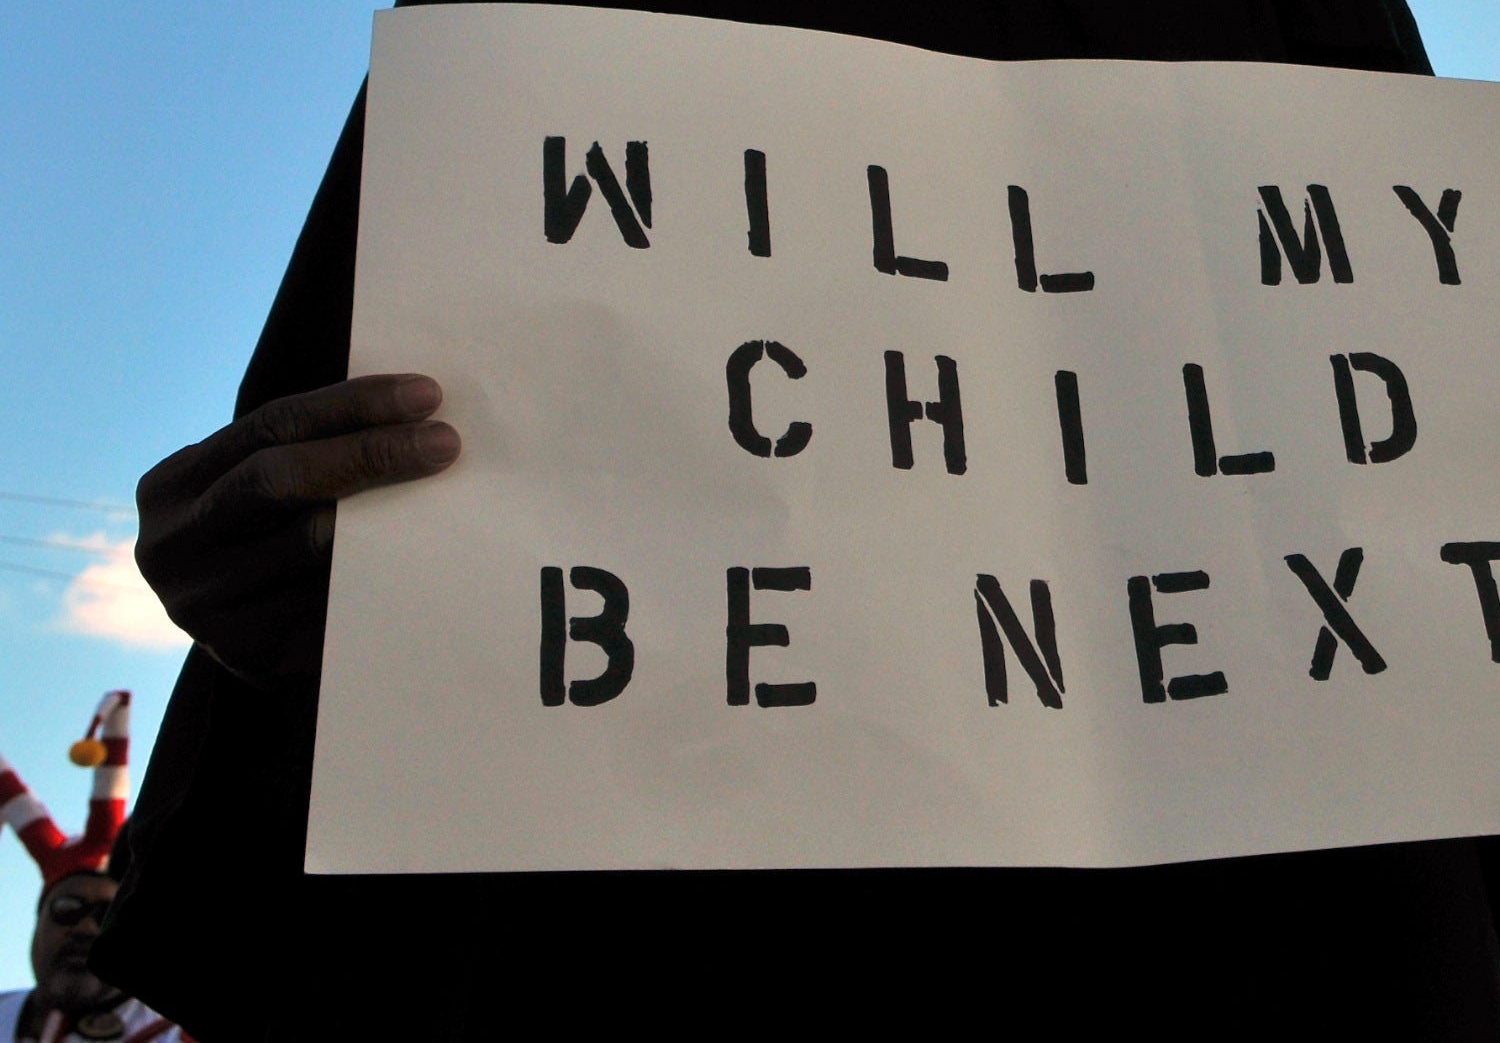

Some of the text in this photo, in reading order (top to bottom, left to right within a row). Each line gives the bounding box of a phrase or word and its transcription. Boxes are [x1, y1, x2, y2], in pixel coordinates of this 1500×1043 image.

[542, 135, 1463, 294] WILL MY
[725, 339, 1418, 486] CHILD
[539, 565, 817, 710] BE
